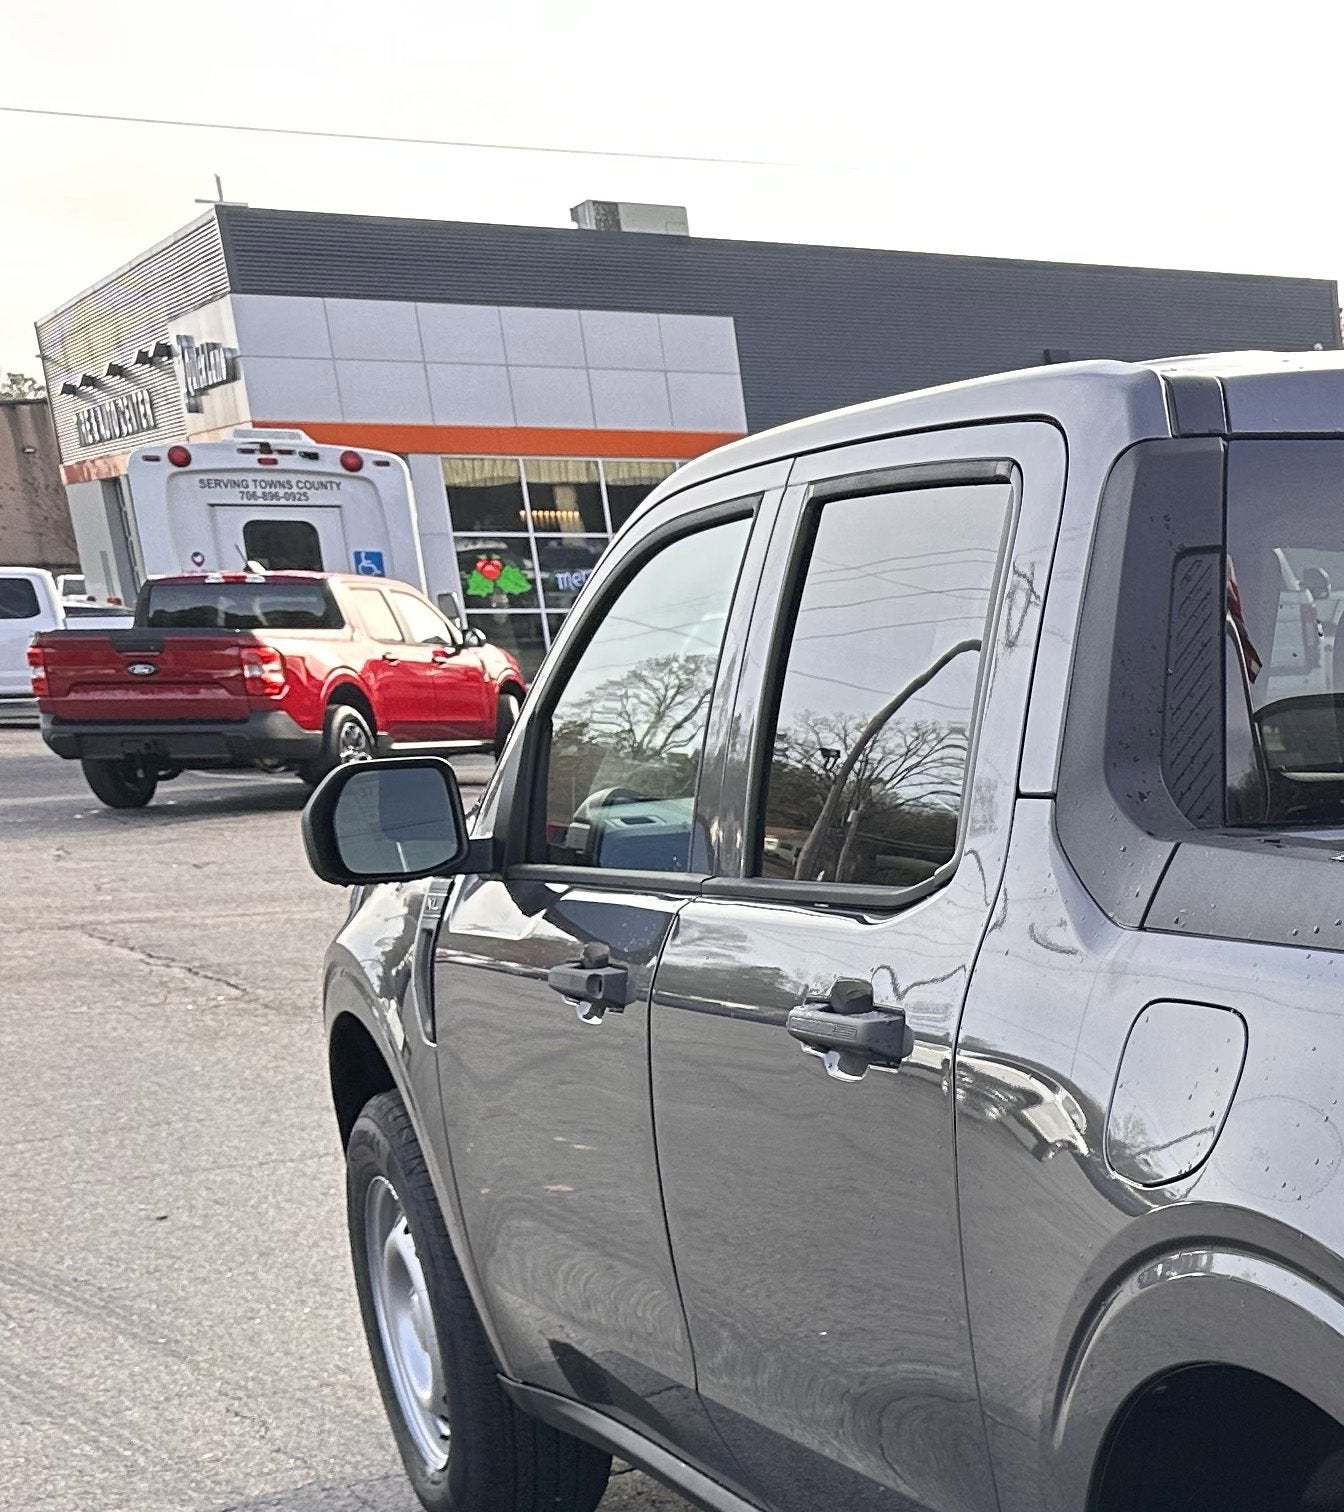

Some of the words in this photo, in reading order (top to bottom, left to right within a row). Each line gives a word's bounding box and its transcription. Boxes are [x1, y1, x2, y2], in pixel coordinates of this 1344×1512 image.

[198, 478, 250, 490] SERVING
[251, 478, 294, 491] TOWNS
[295, 479, 341, 492] COUNTY
